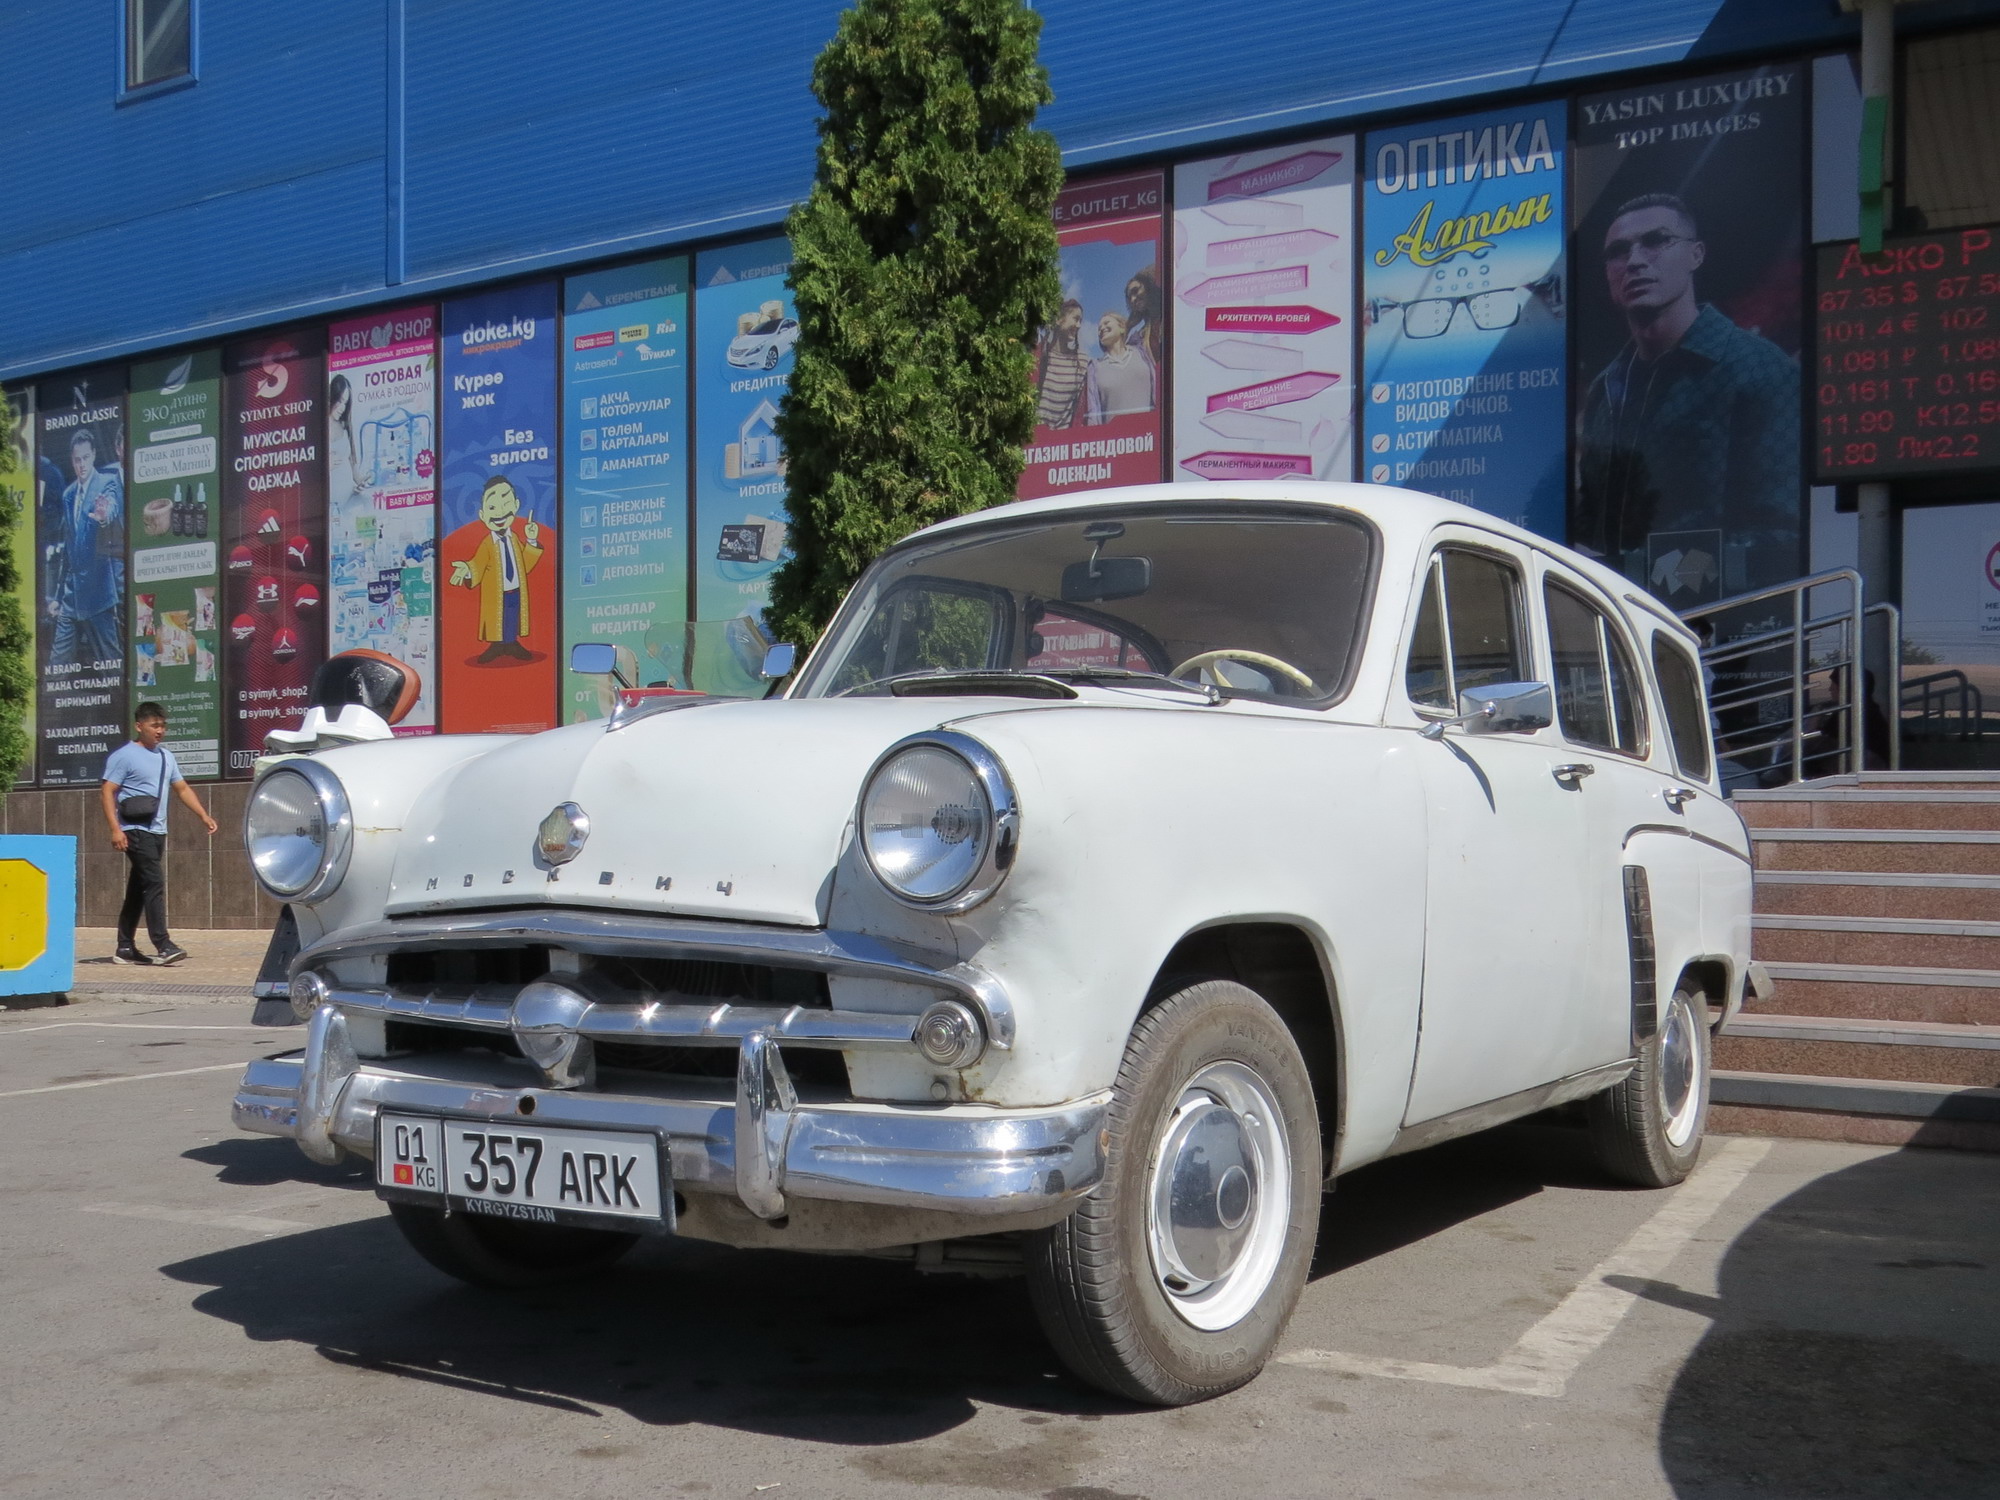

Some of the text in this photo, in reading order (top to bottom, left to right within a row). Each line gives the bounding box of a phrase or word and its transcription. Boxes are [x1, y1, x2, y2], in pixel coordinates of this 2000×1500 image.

[1584, 73, 1794, 125] YASIN LUXURY
[1615, 112, 1761, 150] TOP IMAGES
[1376, 119, 1556, 195] ОПТИКА
[1241, 164, 1305, 191] МАНИКЮР
[1375, 193, 1553, 267] Алтын
[740, 263, 789, 280] КЕРЕМЕТ
[605, 284, 678, 305] КЕРЕМЕТБАНК
[1216, 312, 1311, 323] АРХИТЕКТУРА БРОВЕЙ
[333, 317, 432, 353] BABY SHOP
[463, 315, 536, 346] doke.kg
[575, 356, 617, 372] Astrosend
[641, 349, 676, 361] ШУМКАР
[365, 364, 422, 387] ГОТОВАЯ
[454, 371, 504, 393] Күрөө
[731, 374, 788, 393] КРЕДИТТЕ
[1395, 367, 1560, 401] ИЗГОТОВЛЕНИЕ ВСЕХ
[358, 382, 431, 402] СУМКА В РОДДОМ
[462, 393, 495, 410] жок
[600, 391, 630, 405] АКЧА
[1227, 381, 1292, 403] НАРАЩИВАНИЕ
[240, 399, 313, 423] SYIMYK SHOP
[600, 398, 671, 418] КОТОРУУЛАР
[1243, 395, 1278, 410] РЕСНИЦ
[1396, 394, 1513, 423] ВИДОВ ОЧКОВ.
[45, 406, 119, 431] BRAND CLASSIC
[142, 405, 169, 422] ЭКО
[244, 426, 305, 450] МУЖСКАЯ
[505, 429, 534, 446] Без
[601, 422, 642, 438] ТӨЛӨМ
[1395, 424, 1503, 451] АСТИГМАТИКА
[602, 432, 669, 451] КАРТАЛАРЫ
[1024, 432, 1154, 465] АГАЗИН БРЕНДОВОЙ
[234, 446, 315, 472] СПОРТИВНАЯ
[419, 454, 431, 465] 36
[490, 446, 548, 467] залога
[602, 453, 670, 472] АМАНАТТАР
[1197, 459, 1296, 469] ПЕРМАНЕНТНЫЙ МАКИЯЖ
[1048, 463, 1112, 486] ОДЕЖДЫ
[1395, 457, 1486, 481] БИФОКАЛЫ
[248, 470, 301, 492] ОДЕЖДА
[739, 481, 790, 498] ИПОТЕК
[389, 493, 434, 507] BABY SHOP
[602, 497, 666, 516] ДЕНЕЖНЫЕ
[602, 511, 662, 527] ПЕРЕВОДЫ
[602, 527, 673, 545] ПЛАТЕЖНЫЕ
[602, 544, 640, 558] КАРТЫ
[602, 562, 664, 581] ДЕПОЗИТЫ
[739, 582, 768, 595] КАРТ
[587, 602, 656, 618] НАСЫЯЛАР
[592, 620, 651, 636] КРЕДИТЫ
[53, 663, 81, 675] BRAND
[93, 659, 122, 671] САПАТ
[1716, 672, 1758, 680] УЙРУТМА
[47, 677, 120, 692] ЖАНА СТИЛЬДИН
[248, 685, 308, 700] syimyk_shop2
[55, 694, 111, 708] БИРИМДИГИ!
[248, 706, 309, 720] syimyk_shop
[46, 725, 121, 739] ЗАХОДИТЕ ПРОБА
[58, 743, 108, 755] БЕСПЛАТНА
[425, 867, 734, 896] МОСКВИЧ
[395, 1124, 428, 1163] 01
[416, 1166, 435, 1188] KG
[463, 1132, 641, 1208] 357 ARK
[465, 1198, 555, 1223] KYRGYZSTAN
